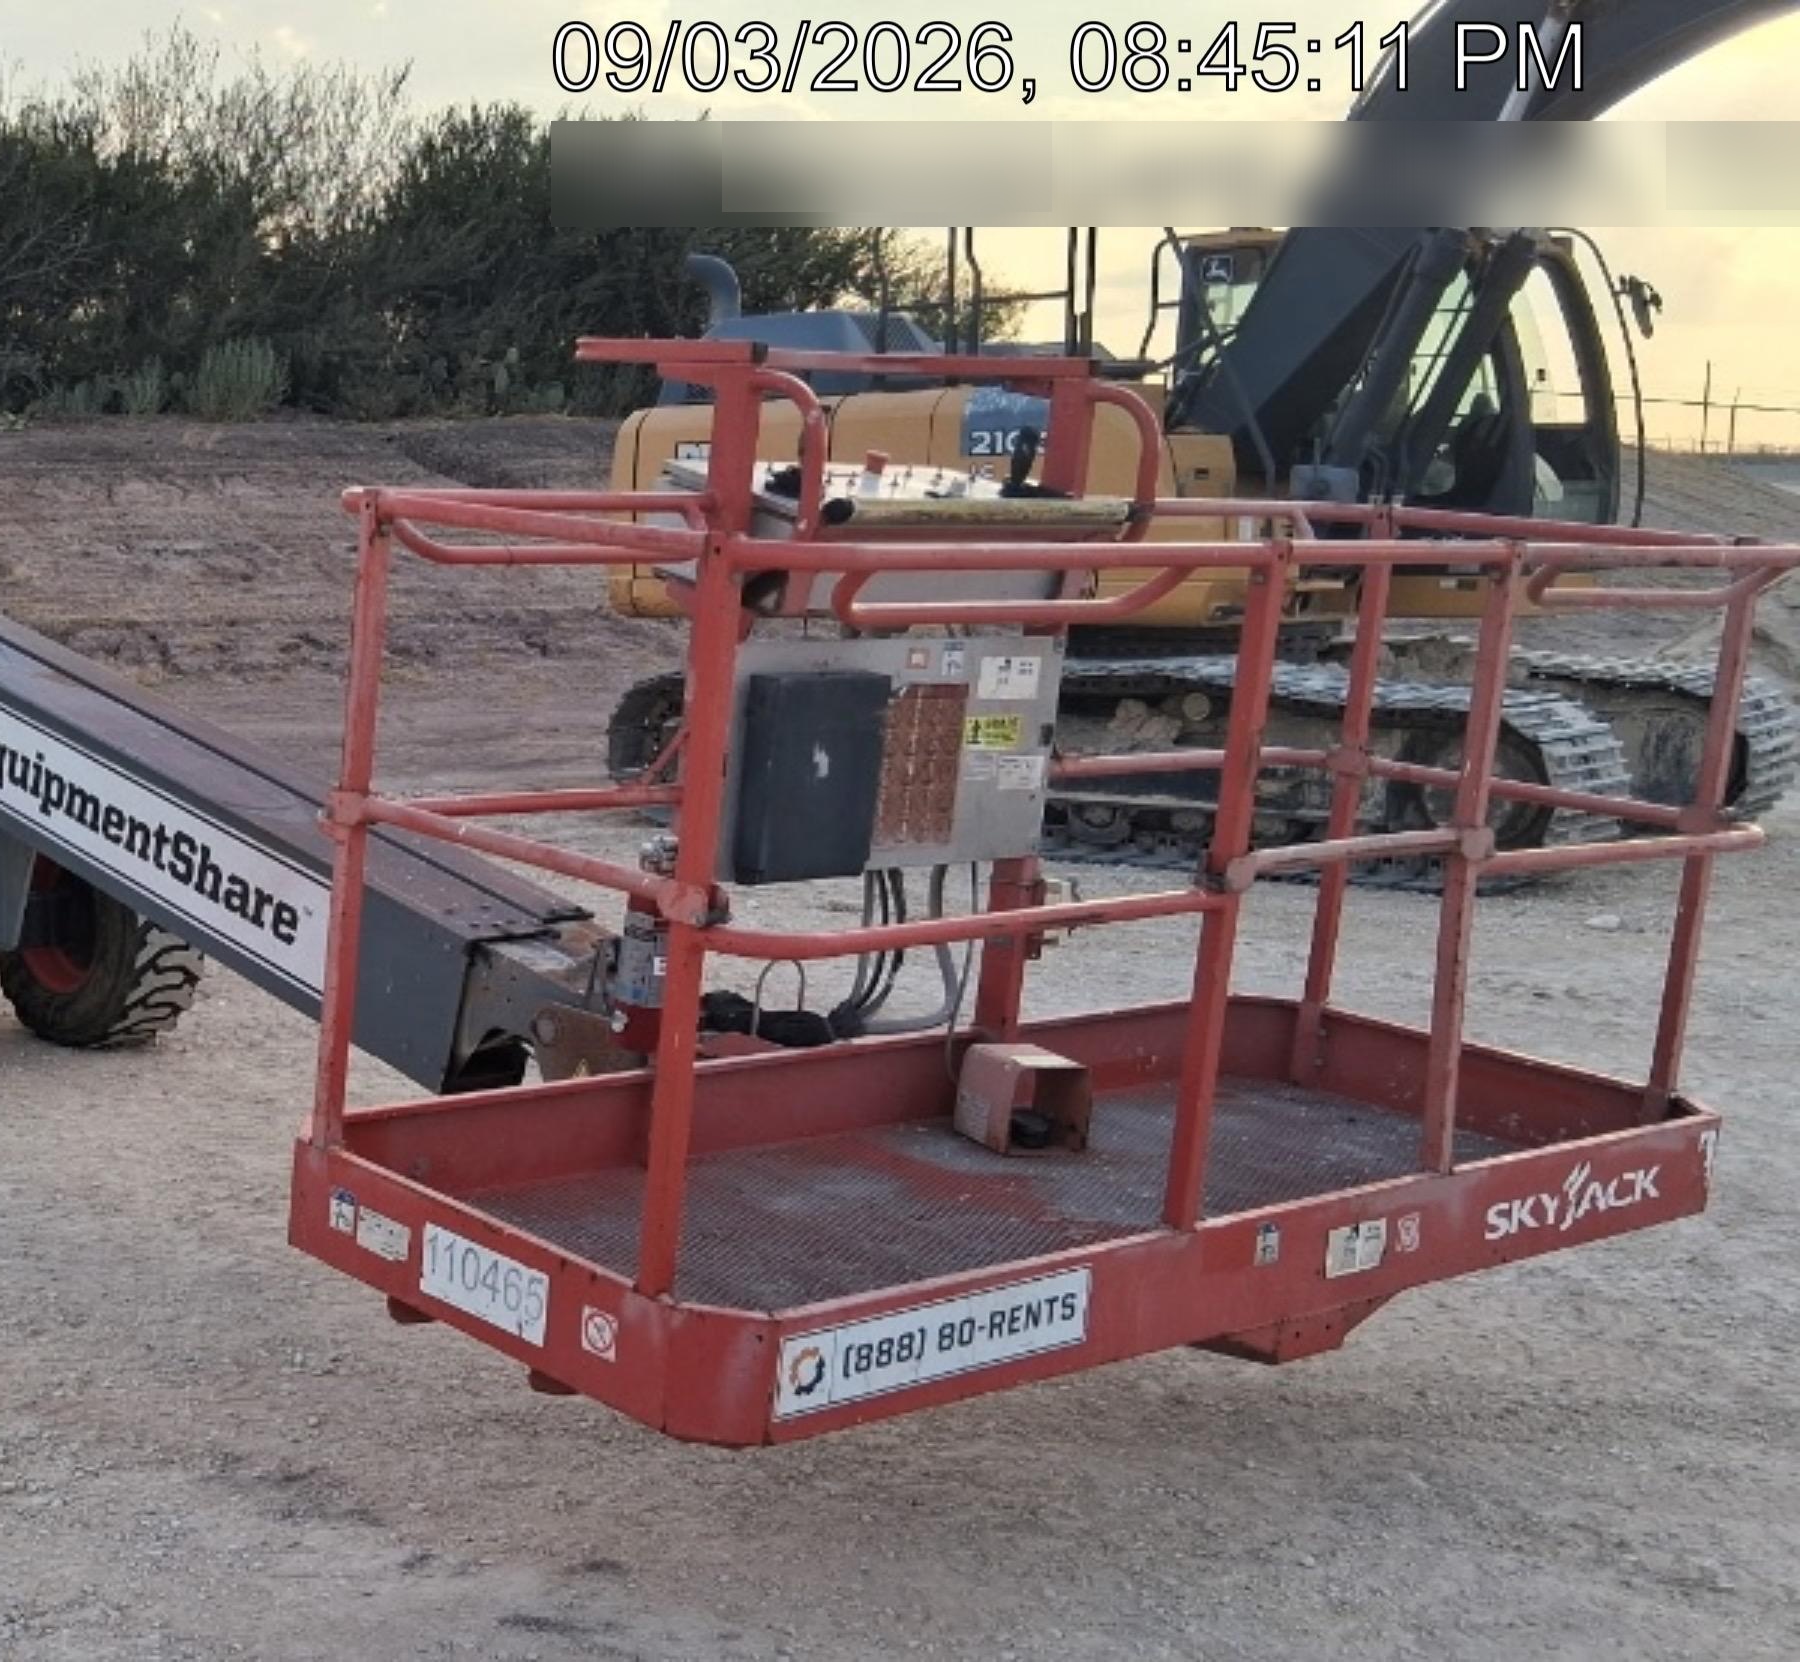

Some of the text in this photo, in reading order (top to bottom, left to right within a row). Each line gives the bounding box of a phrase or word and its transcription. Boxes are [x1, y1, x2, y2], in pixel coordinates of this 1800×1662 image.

[1484, 1160, 1662, 1240] SKYJACK
[428, 1231, 546, 1324] 110465
[841, 1292, 1078, 1378] (888) 80-RENTS
